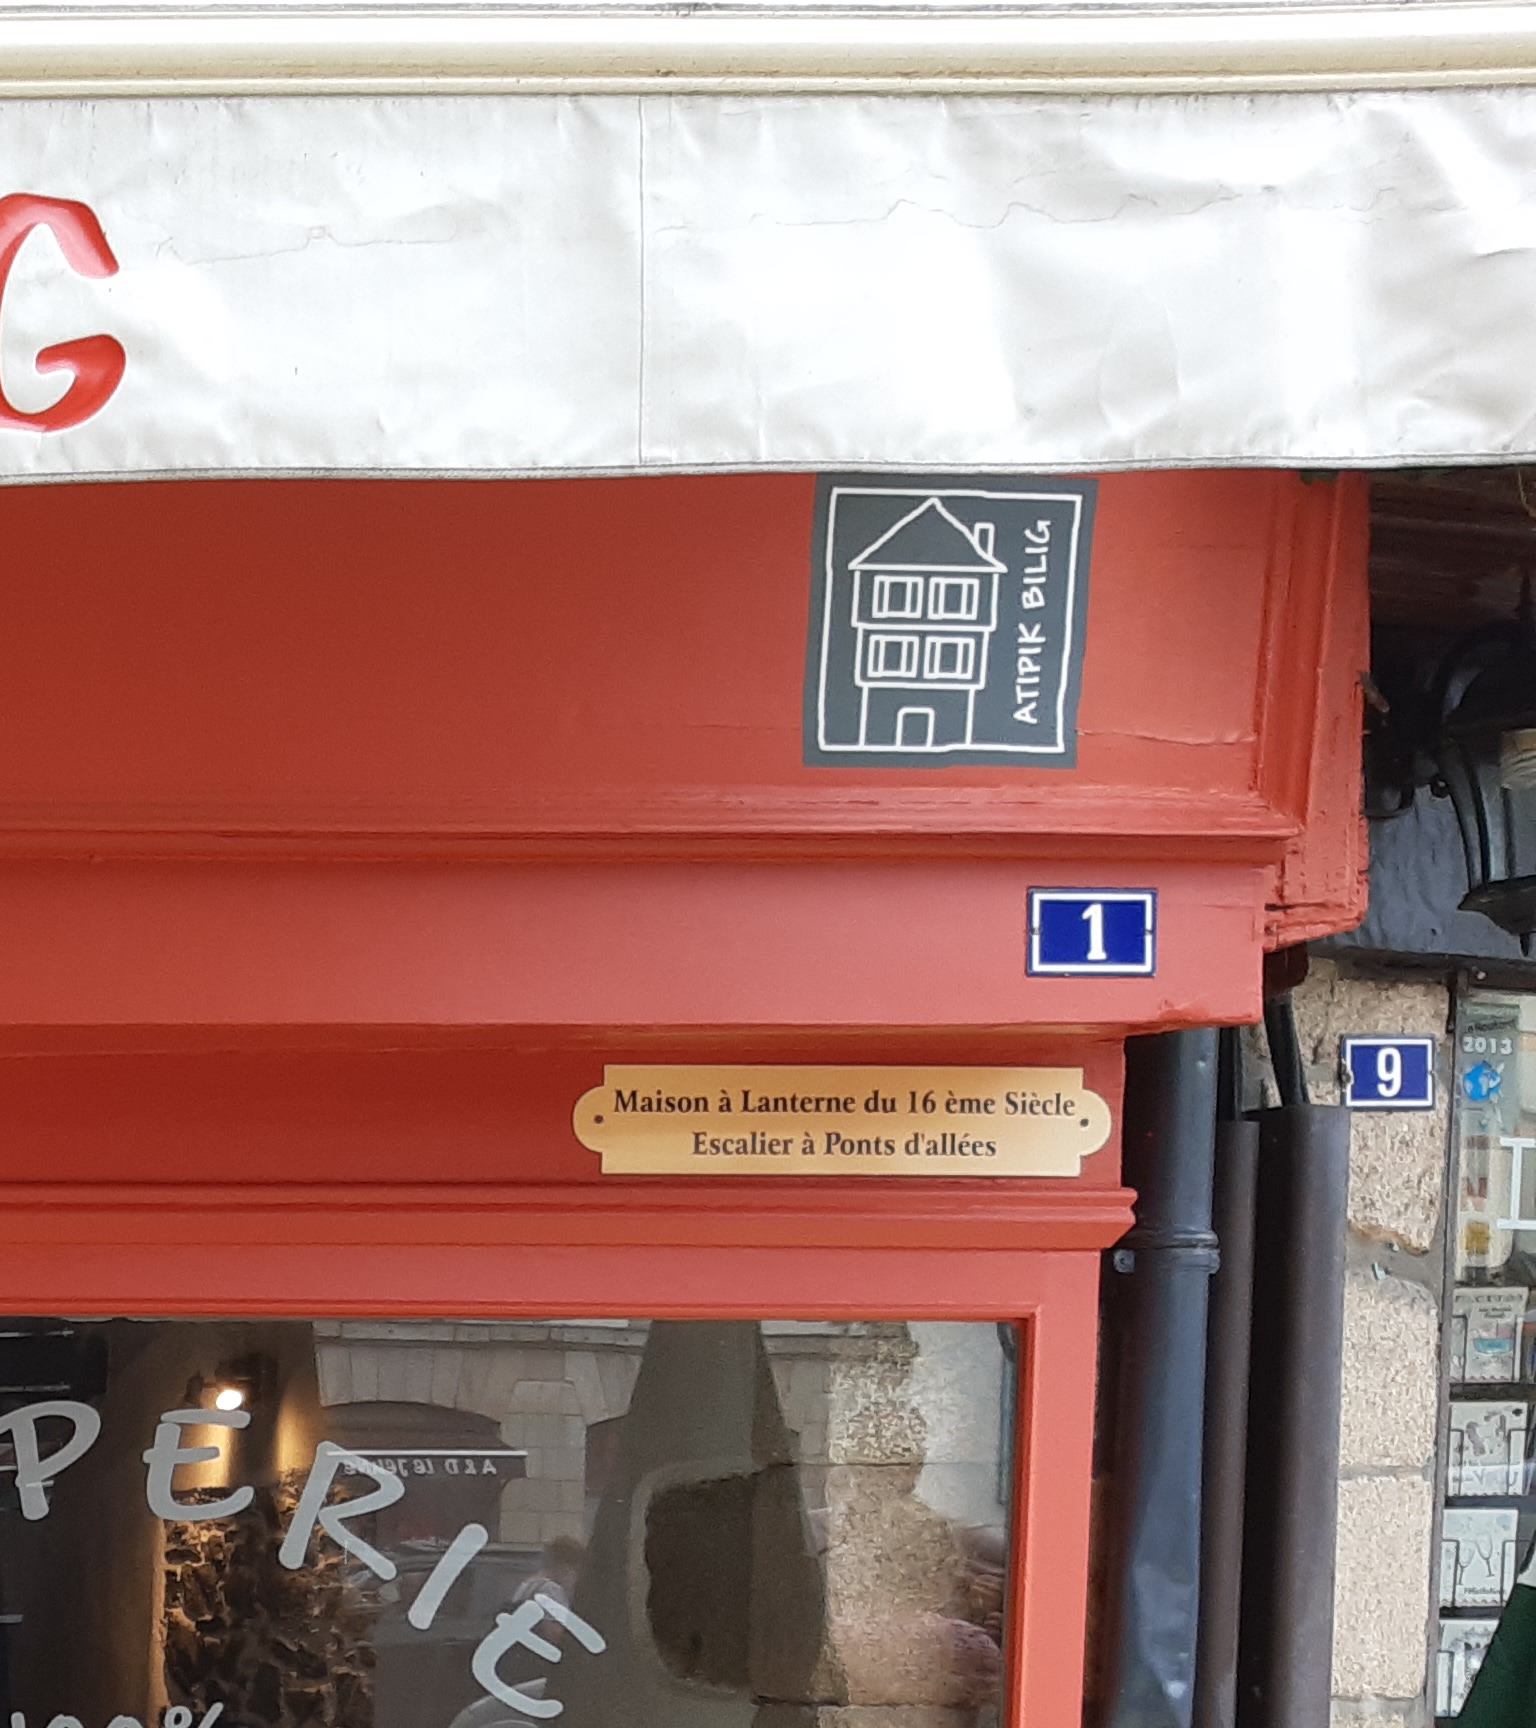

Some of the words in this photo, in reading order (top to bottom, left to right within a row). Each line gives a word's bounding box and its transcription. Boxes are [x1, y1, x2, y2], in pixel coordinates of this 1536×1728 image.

[1021, 519, 1052, 610] BILIG
[1012, 622, 1047, 725] ATIPIK
[1081, 903, 1108, 961] 1
[1461, 1035, 1513, 1056] 2013
[1377, 1047, 1402, 1098] 9
[613, 1089, 710, 1115] Maison
[717, 1088, 734, 1114] à
[740, 1090, 856, 1115] Lanterne
[863, 1088, 897, 1115] du
[907, 1089, 936, 1115] 16
[944, 1090, 996, 1116] ème
[1004, 1091, 1076, 1118] Siècle
[691, 1130, 793, 1157] Escalier
[801, 1131, 816, 1157] à
[824, 1131, 895, 1157] Ponts
[904, 1131, 997, 1157] d'allées
